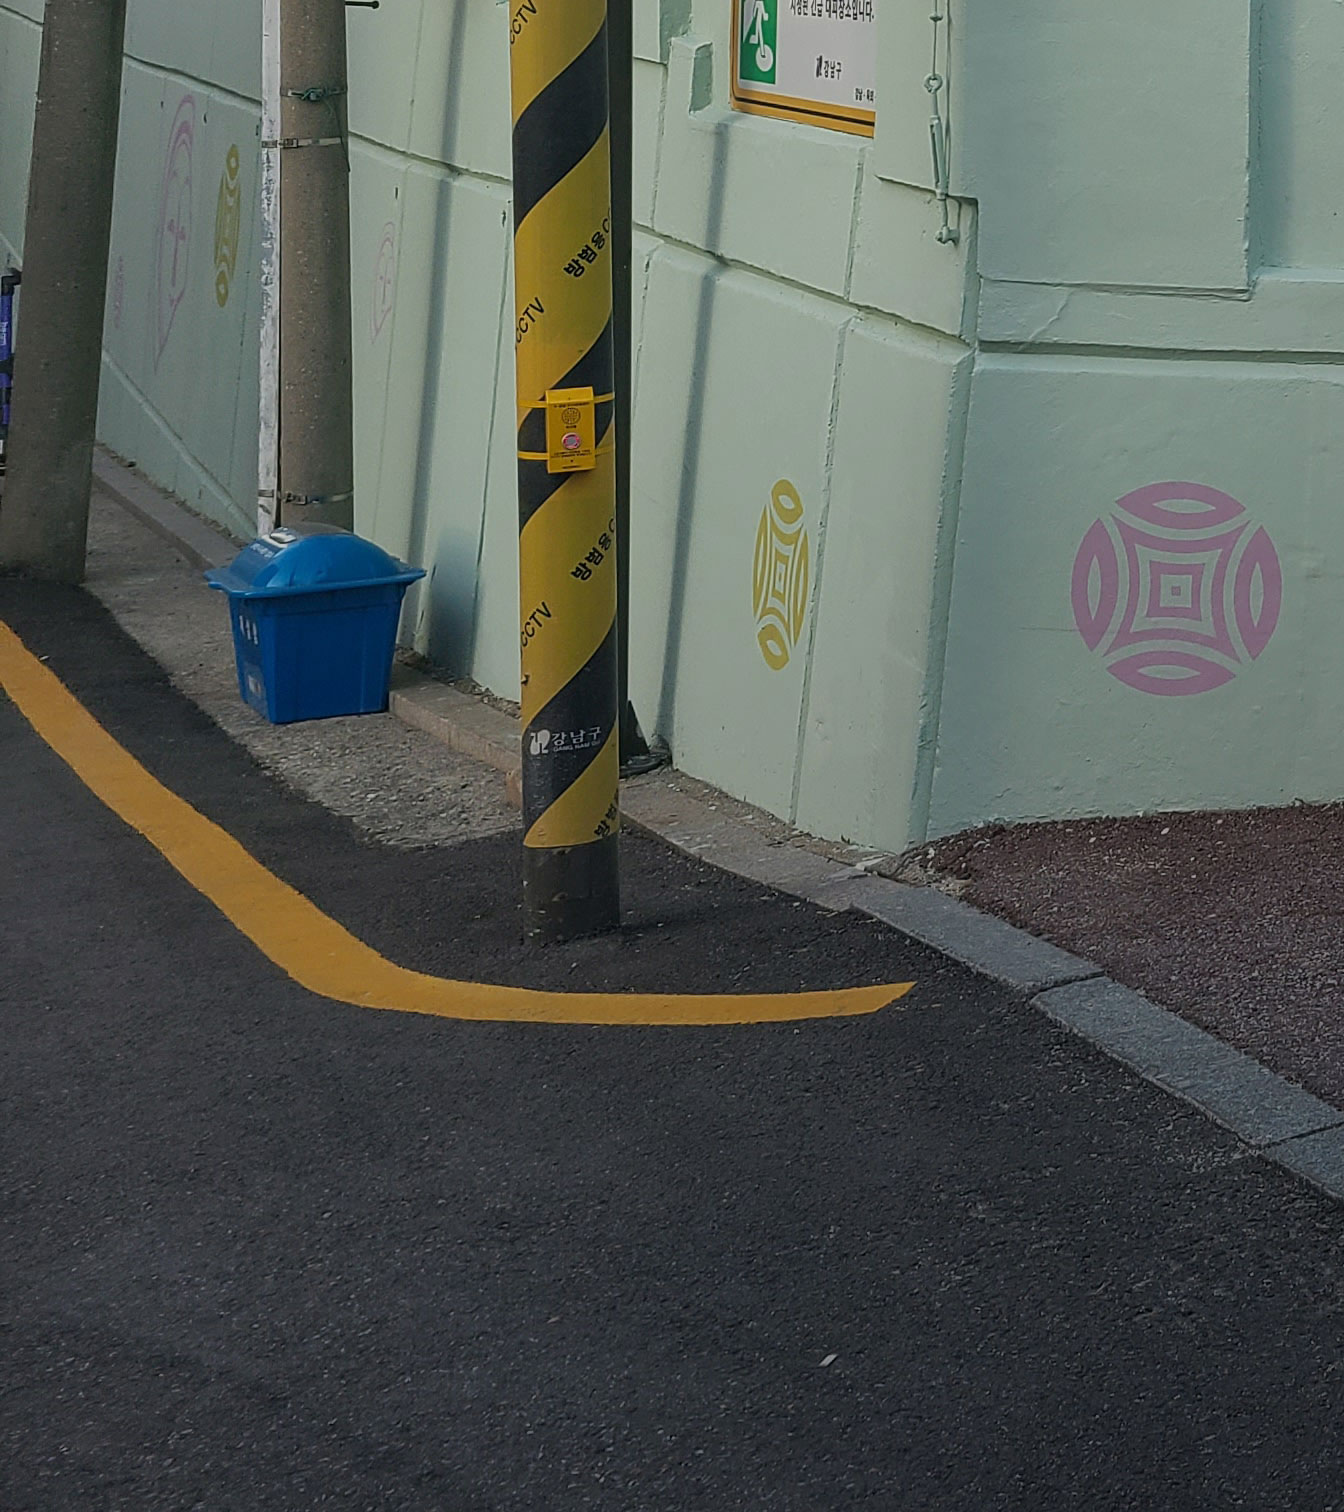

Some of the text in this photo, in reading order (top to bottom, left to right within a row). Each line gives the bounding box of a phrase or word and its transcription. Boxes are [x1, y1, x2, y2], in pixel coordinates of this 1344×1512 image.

[823, 59, 842, 81] 강남구
[563, 231, 606, 278] 방범용
[571, 533, 612, 582] 방범용
[551, 726, 602, 747] 강남구
